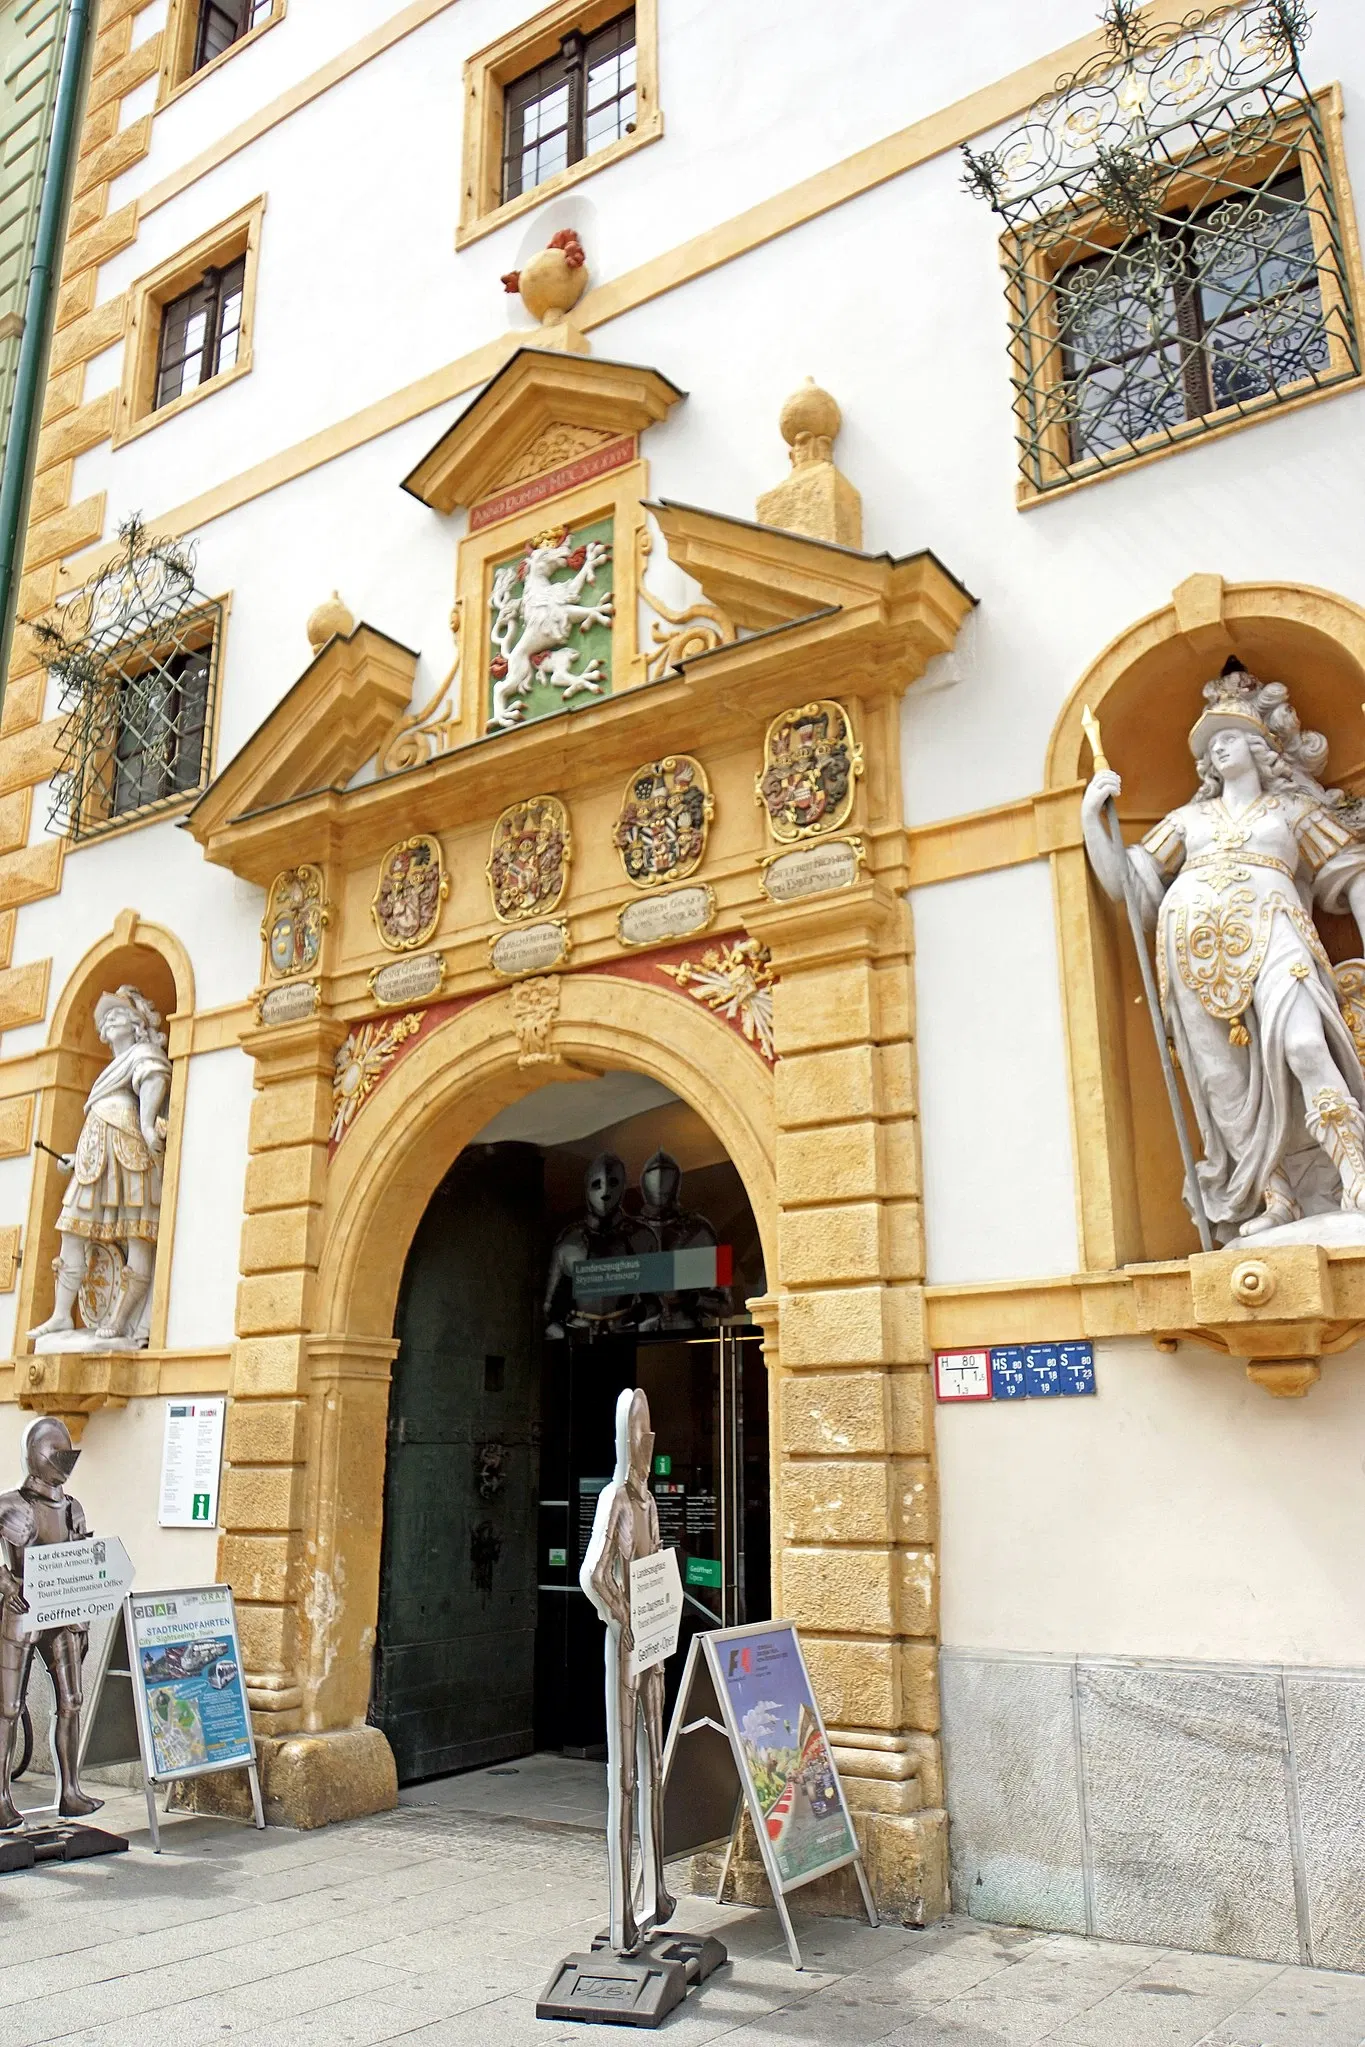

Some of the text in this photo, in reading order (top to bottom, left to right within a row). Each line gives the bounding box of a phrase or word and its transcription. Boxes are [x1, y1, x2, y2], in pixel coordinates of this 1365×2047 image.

[575, 1260, 639, 1273] Landeszeughaus
[575, 1270, 640, 1286] Styrian Armoury
[941, 1355, 975, 1367] H 80
[992, 1357, 1022, 1371] HS 80
[1026, 1355, 1057, 1368] S 80
[1060, 1353, 1091, 1366] S 80
[37, 1557, 94, 1573] Styrian Armoury
[689, 1565, 713, 1575] Geöffnet
[37, 1574, 94, 1589] Graz Tourismus
[37, 1578, 124, 1598] Tourist Information Office
[37, 1602, 115, 1623] Geöffnet Open
[134, 1602, 177, 1619] GRAZ
[146, 1618, 231, 1636] STADTRUNDFAHRTEN
[139, 1637, 152, 1646] City
[156, 1632, 196, 1644] Sightseeing
